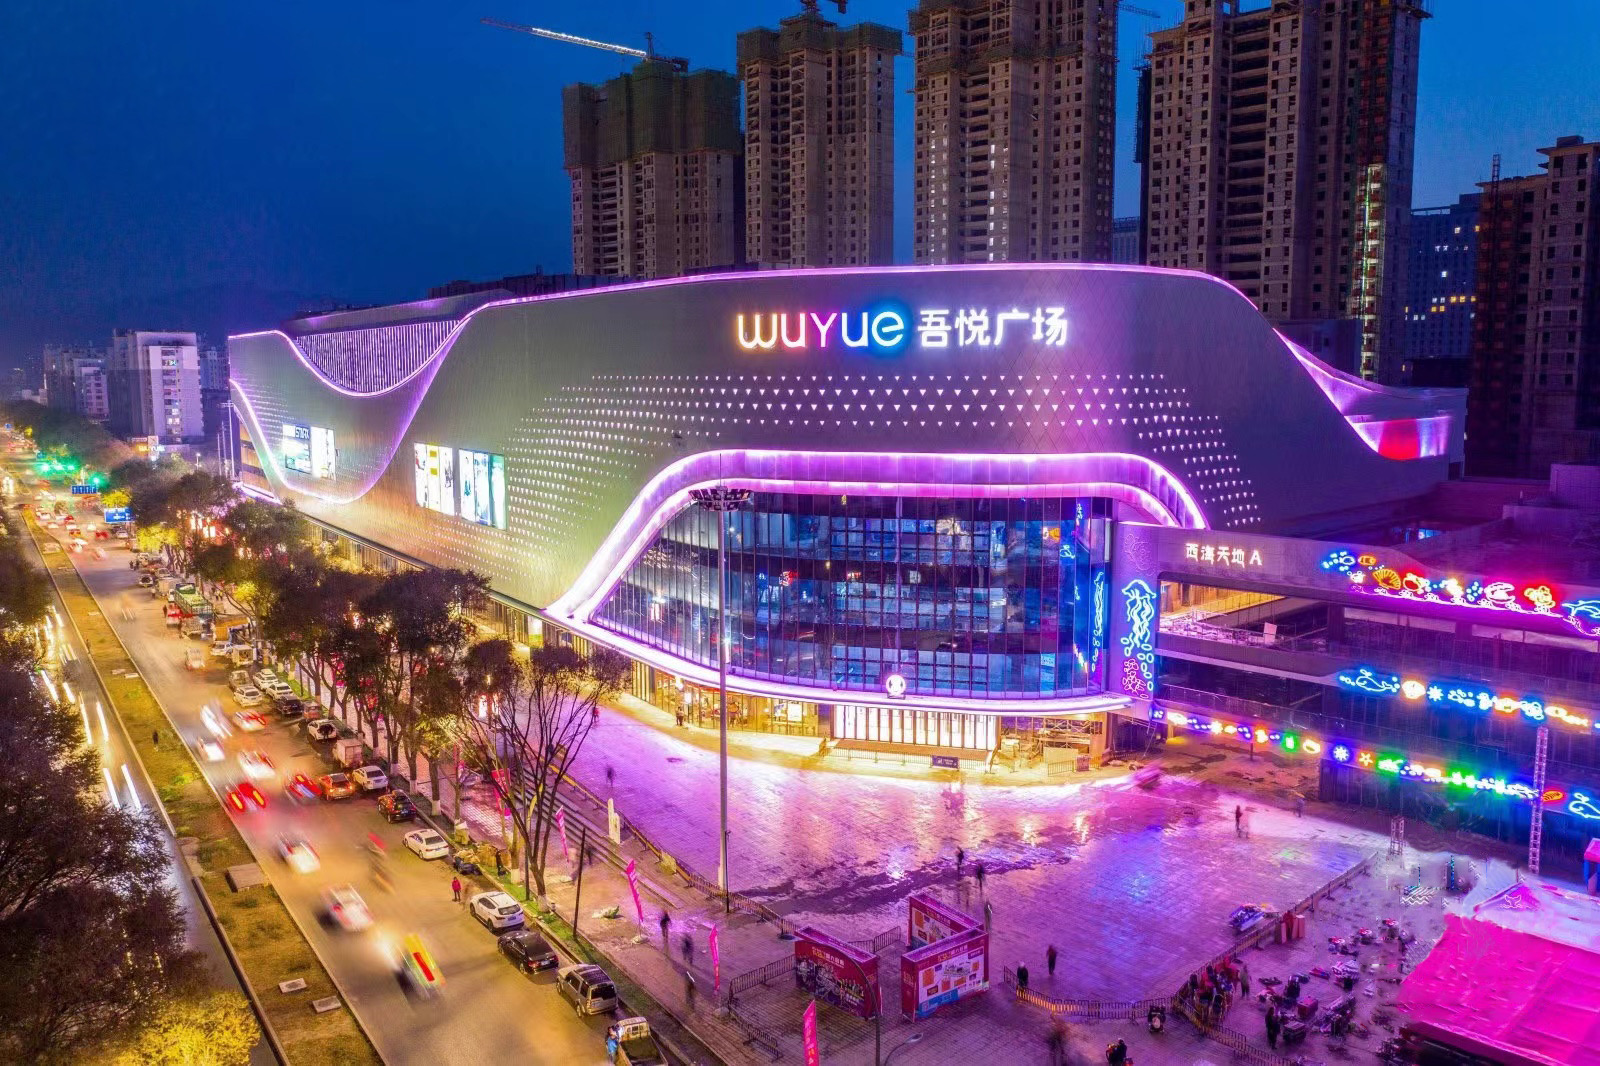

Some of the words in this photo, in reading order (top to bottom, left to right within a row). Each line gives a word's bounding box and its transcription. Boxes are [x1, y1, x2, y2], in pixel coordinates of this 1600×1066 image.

[917, 307, 1069, 347] 吾悦广场
[1185, 543, 1246, 568] 西海天地
[1249, 550, 1263, 566] A
